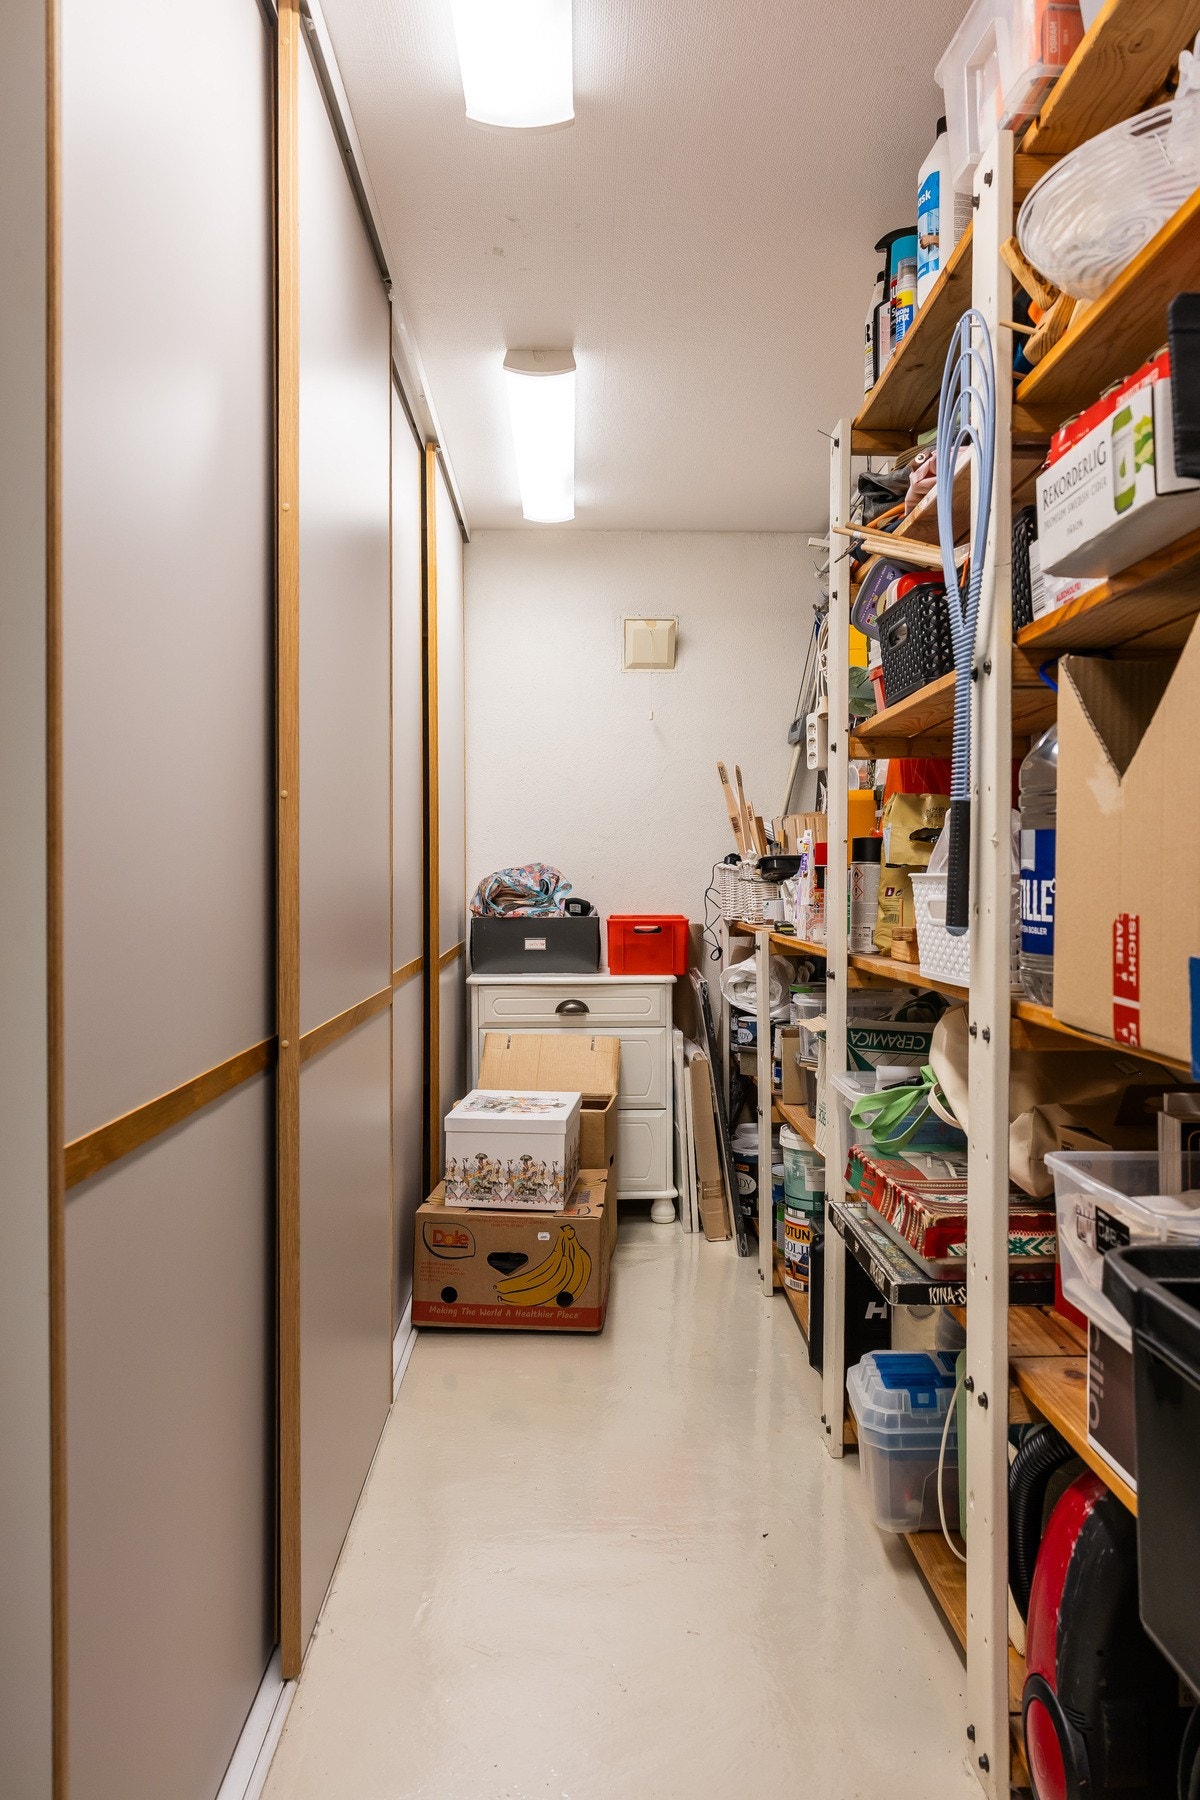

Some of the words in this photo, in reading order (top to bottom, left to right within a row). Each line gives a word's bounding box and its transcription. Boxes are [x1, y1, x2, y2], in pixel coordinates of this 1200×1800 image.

[1050, 21, 1058, 53] OSRAM
[1042, 441, 1106, 511] REKORDERLIG
[850, 1030, 926, 1050] CERAMICA
[432, 1229, 470, 1246] Dole
[428, 1305, 458, 1317] Making
[462, 1307, 476, 1316] The
[479, 1307, 501, 1317] World
[505, 1309, 511, 1317] A
[515, 1309, 553, 1319] Healthier
[556, 1310, 580, 1320] Place
